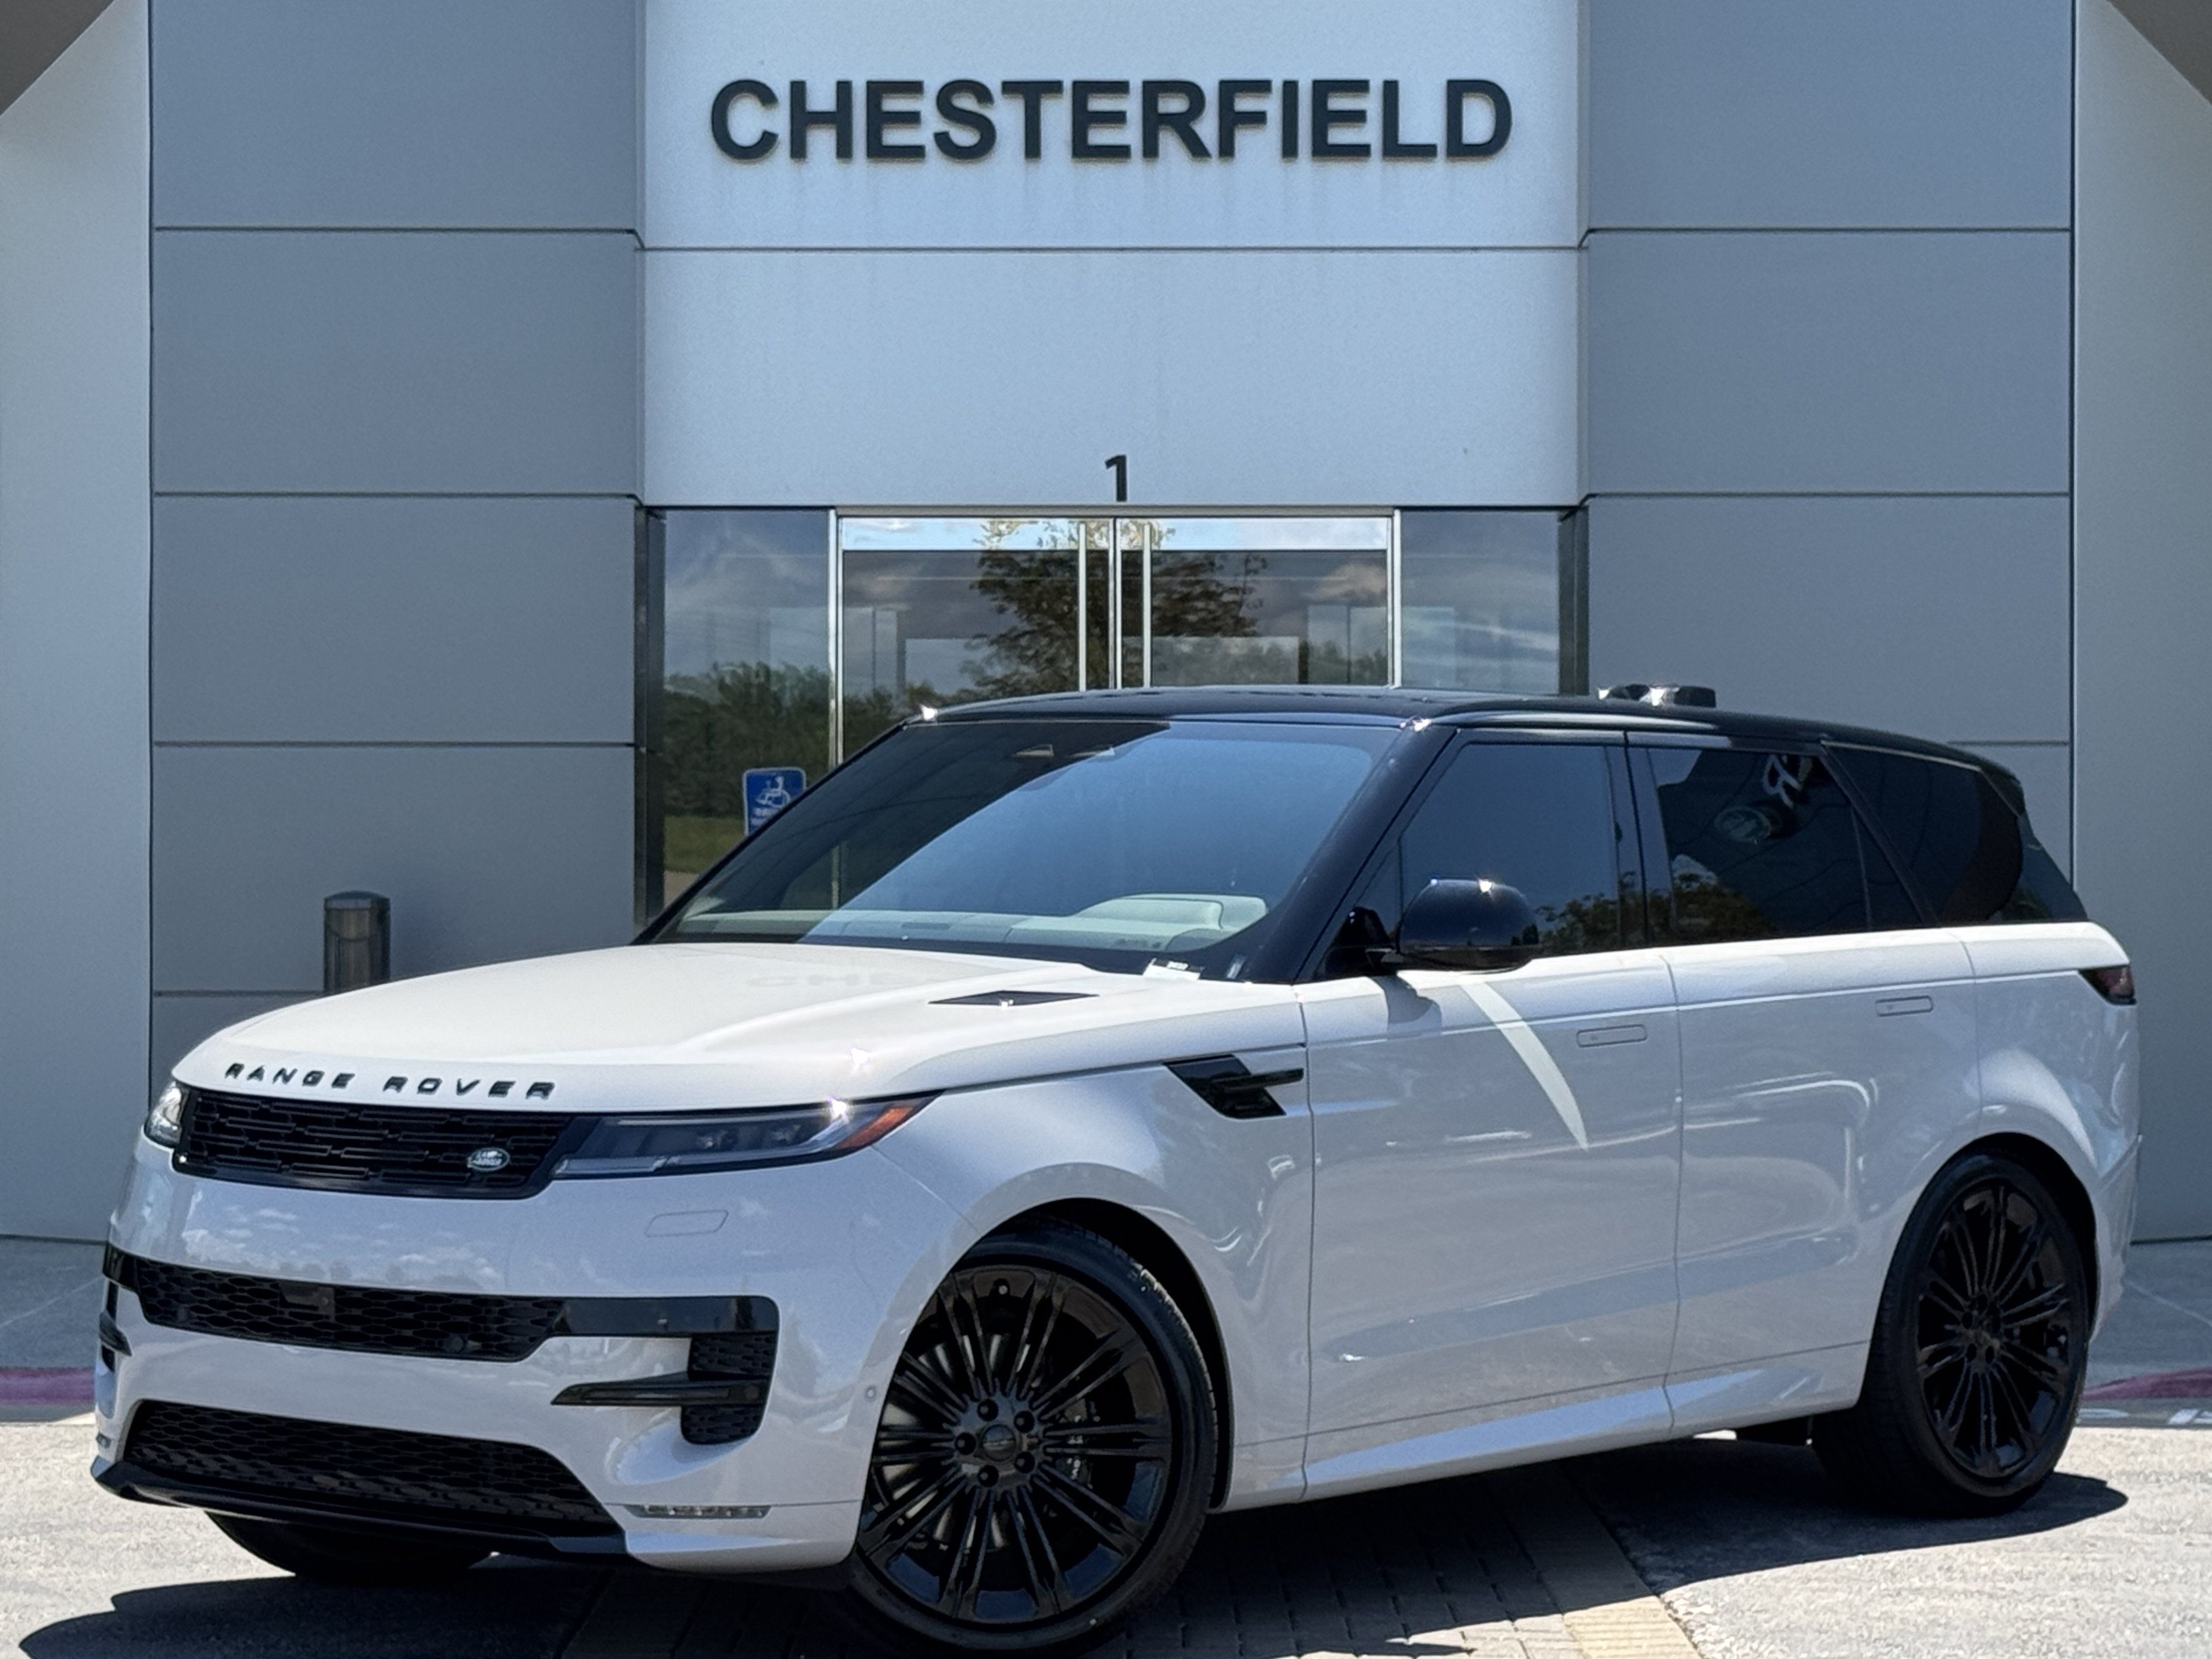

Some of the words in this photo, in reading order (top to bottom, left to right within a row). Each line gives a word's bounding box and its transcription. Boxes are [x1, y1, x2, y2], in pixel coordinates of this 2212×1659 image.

[711, 80, 1512, 162] CHESTERFIELD
[1105, 454, 1127, 503] 1
[225, 1063, 356, 1088] RANGE
[382, 1076, 555, 1099] ROVER
